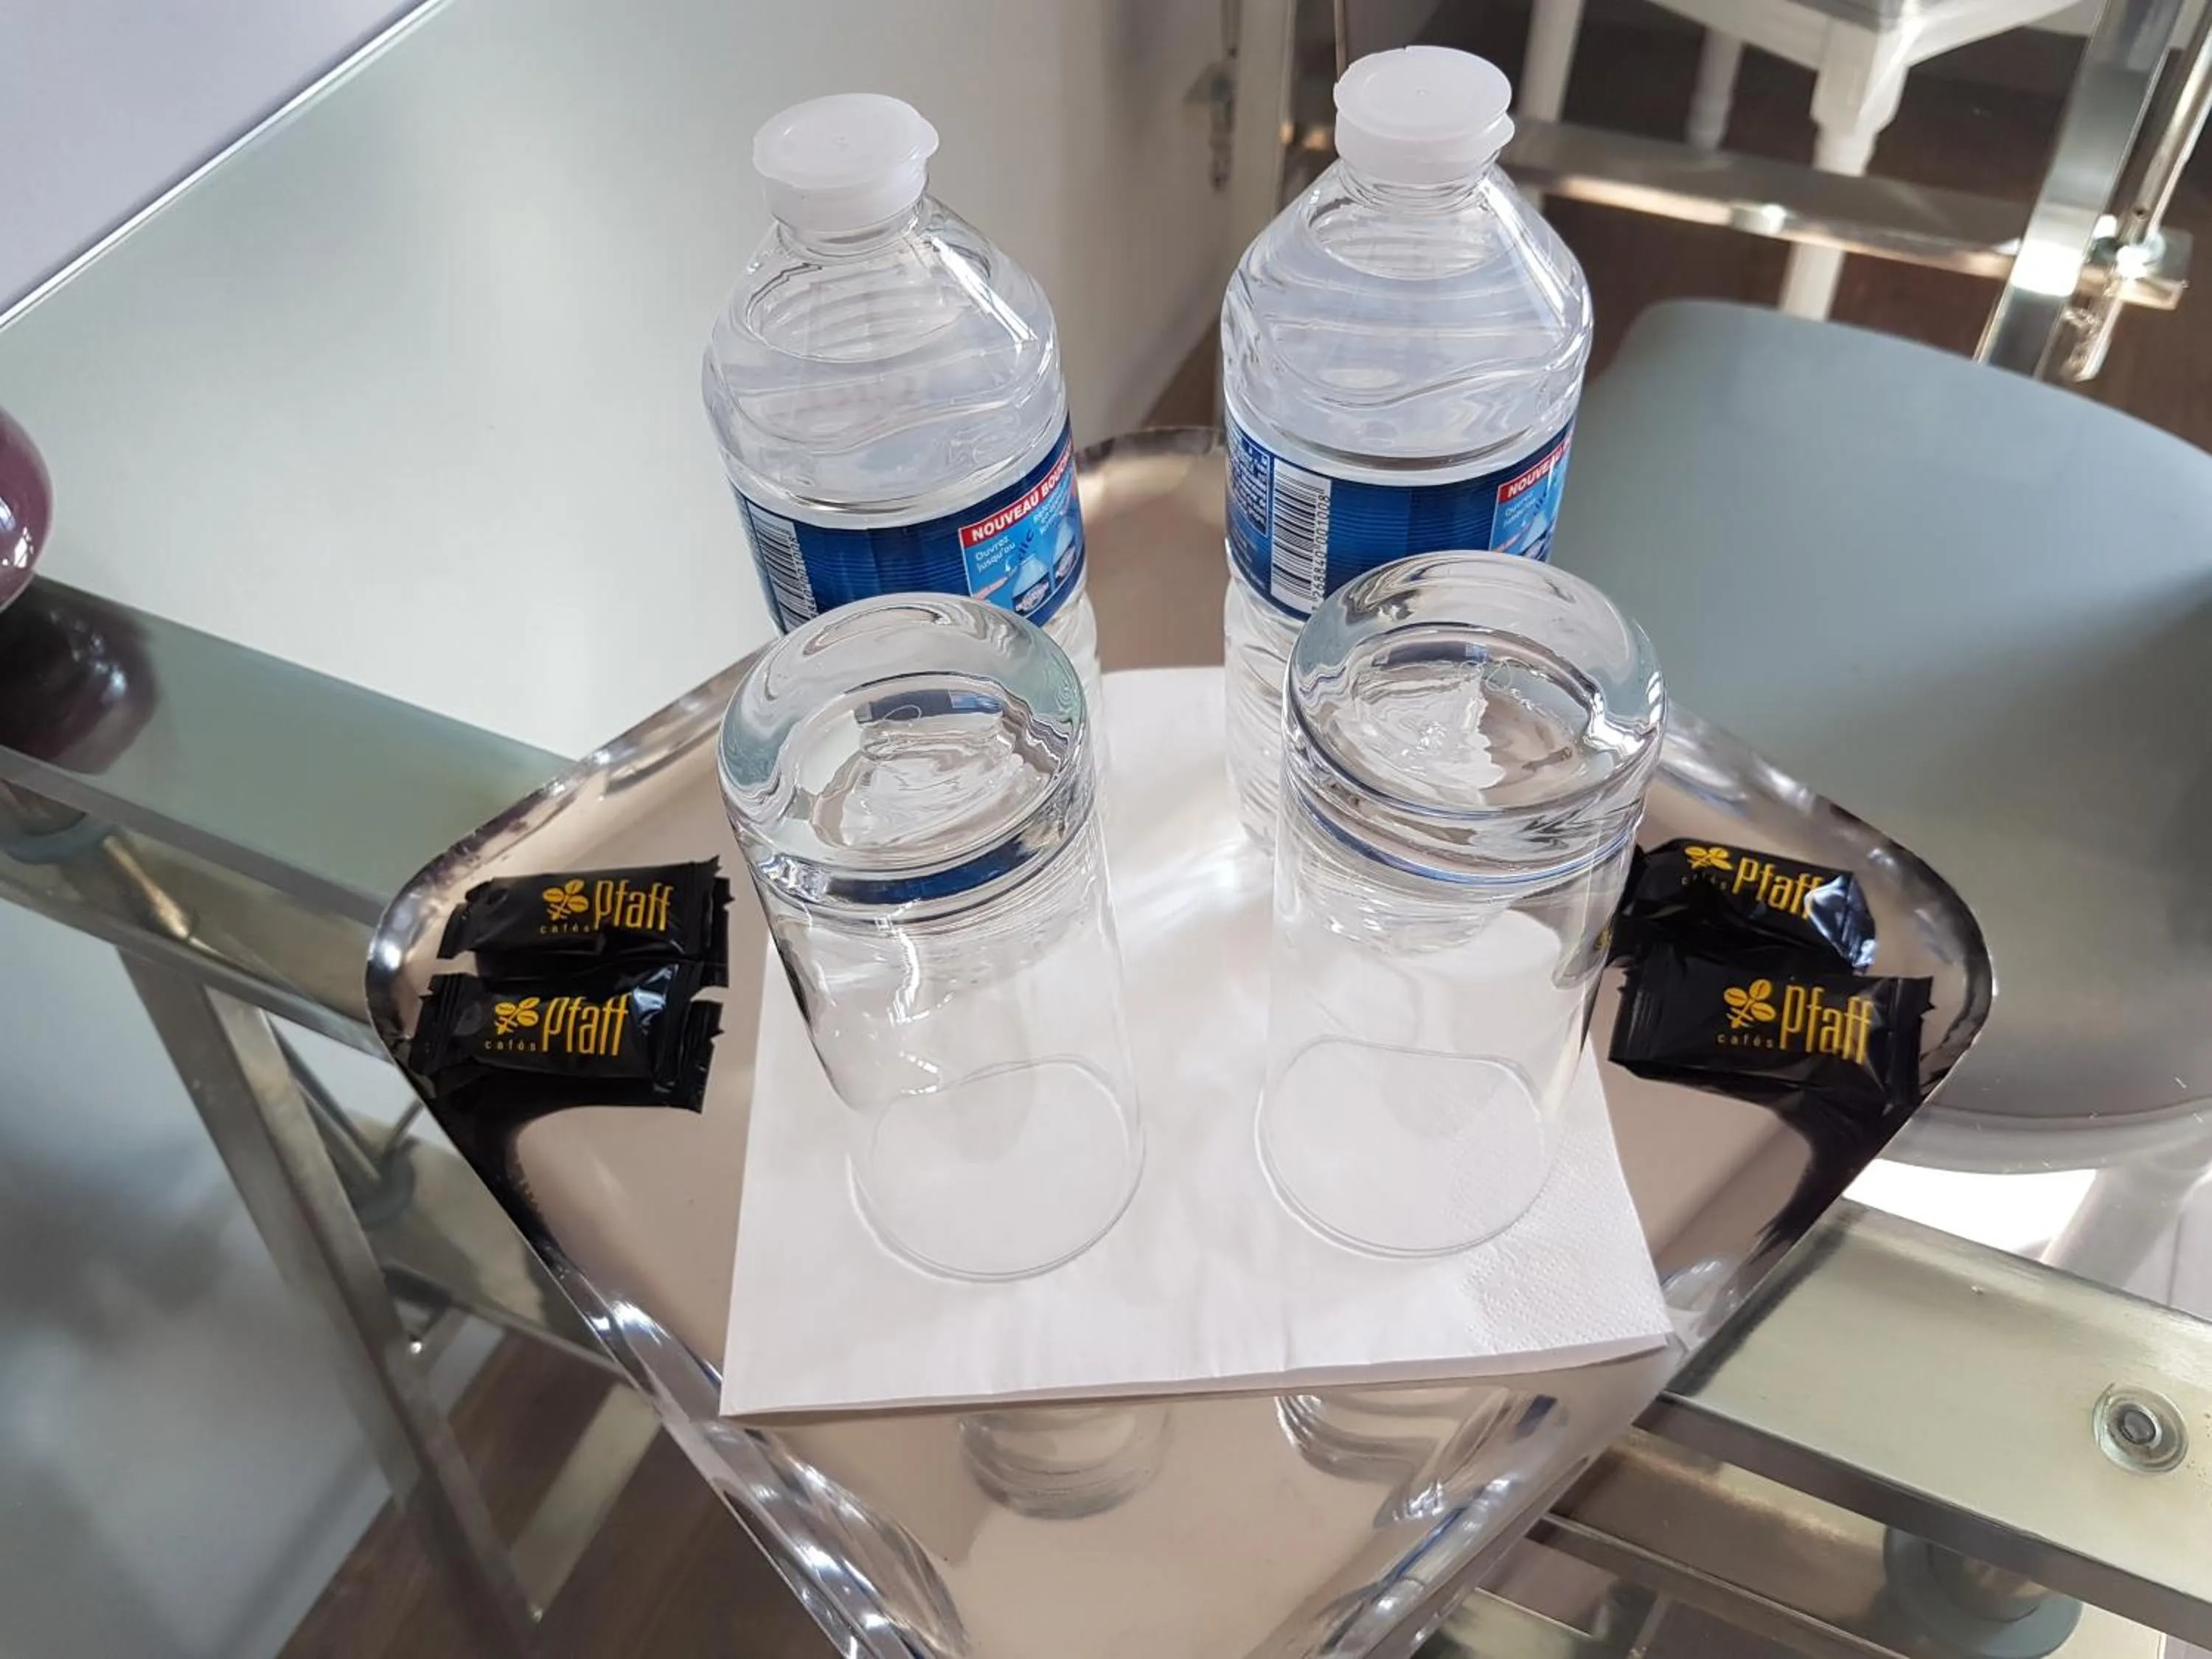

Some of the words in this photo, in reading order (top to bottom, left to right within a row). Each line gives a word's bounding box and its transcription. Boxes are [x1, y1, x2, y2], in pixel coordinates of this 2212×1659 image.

[971, 491, 1040, 541] NOUVEAU
[1315, 495, 1330, 545] 001008
[975, 535, 1010, 560] Ouvrez
[1312, 551, 1326, 598] 268840
[540, 923, 590, 934] cafés
[594, 879, 674, 931] Pfaff
[1732, 857, 1826, 920] Pfaff
[484, 1040, 537, 1051] cafés
[542, 992, 632, 1057] Pfaff
[1717, 1033, 1774, 1049] cafés
[1779, 984, 1874, 1065] Pfaff
